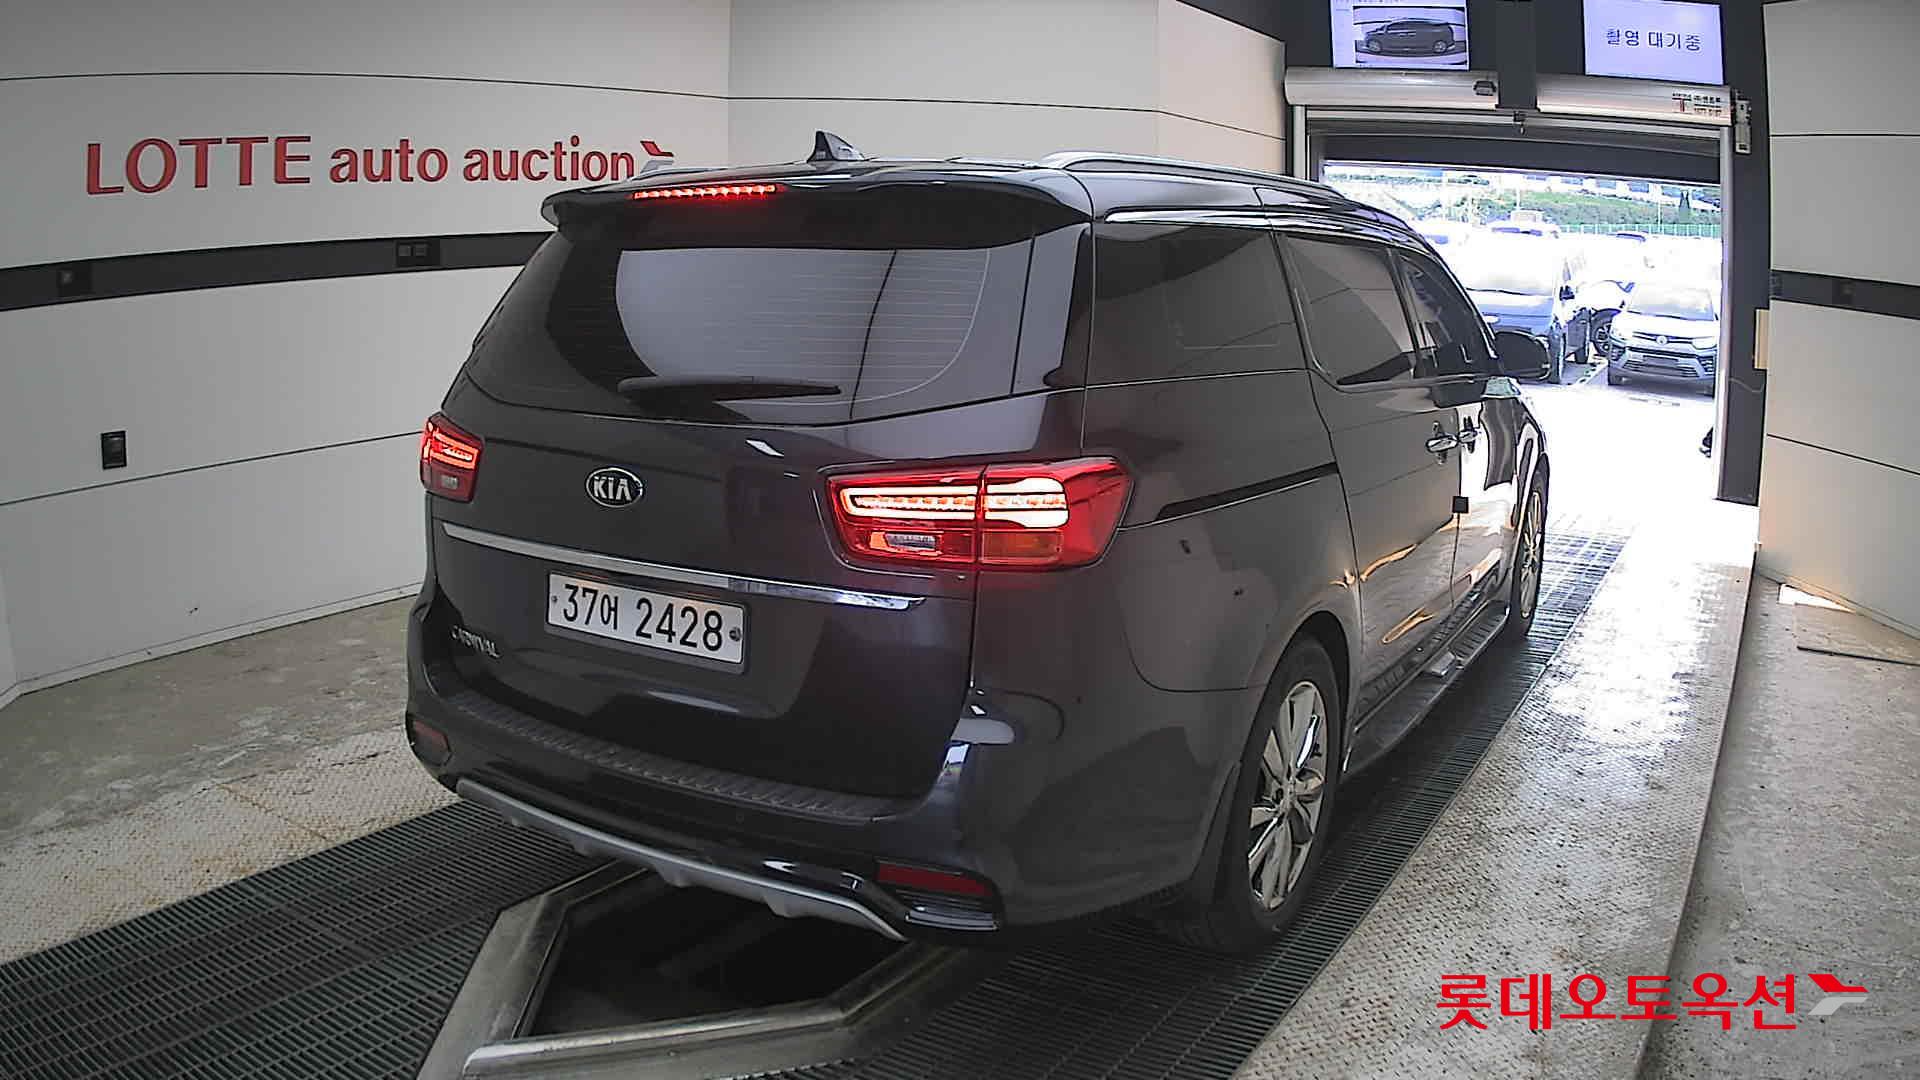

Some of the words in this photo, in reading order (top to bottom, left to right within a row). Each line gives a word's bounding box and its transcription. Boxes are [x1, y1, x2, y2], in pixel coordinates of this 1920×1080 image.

[1647, 31, 1701, 51] 대기중
[86, 135, 312, 196] LOTTE
[328, 138, 449, 184] auto
[462, 135, 635, 183] auction
[593, 475, 632, 501] KIA
[563, 583, 619, 630] 37어
[635, 597, 723, 651] 2428
